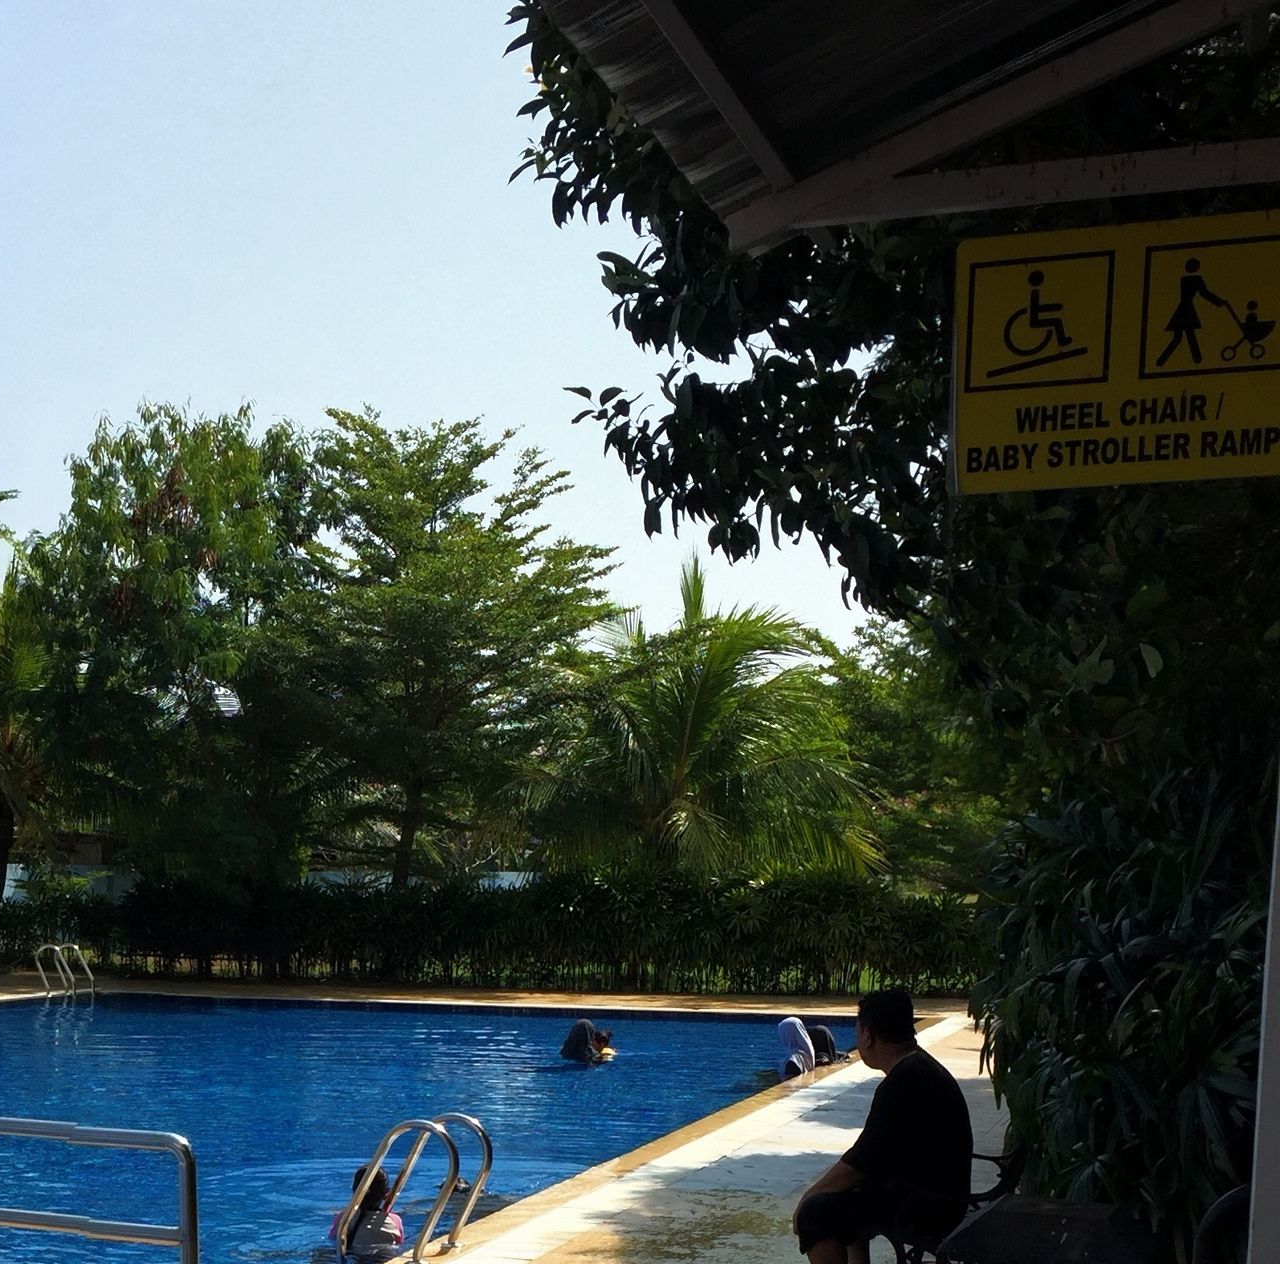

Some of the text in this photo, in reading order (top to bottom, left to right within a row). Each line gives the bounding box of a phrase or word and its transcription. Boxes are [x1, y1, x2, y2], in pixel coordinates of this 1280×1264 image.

[1016, 402, 1110, 433] WHEEL
[1120, 394, 1207, 426] CHAIR
[966, 427, 1280, 473] BABY STROLLER RAMP
